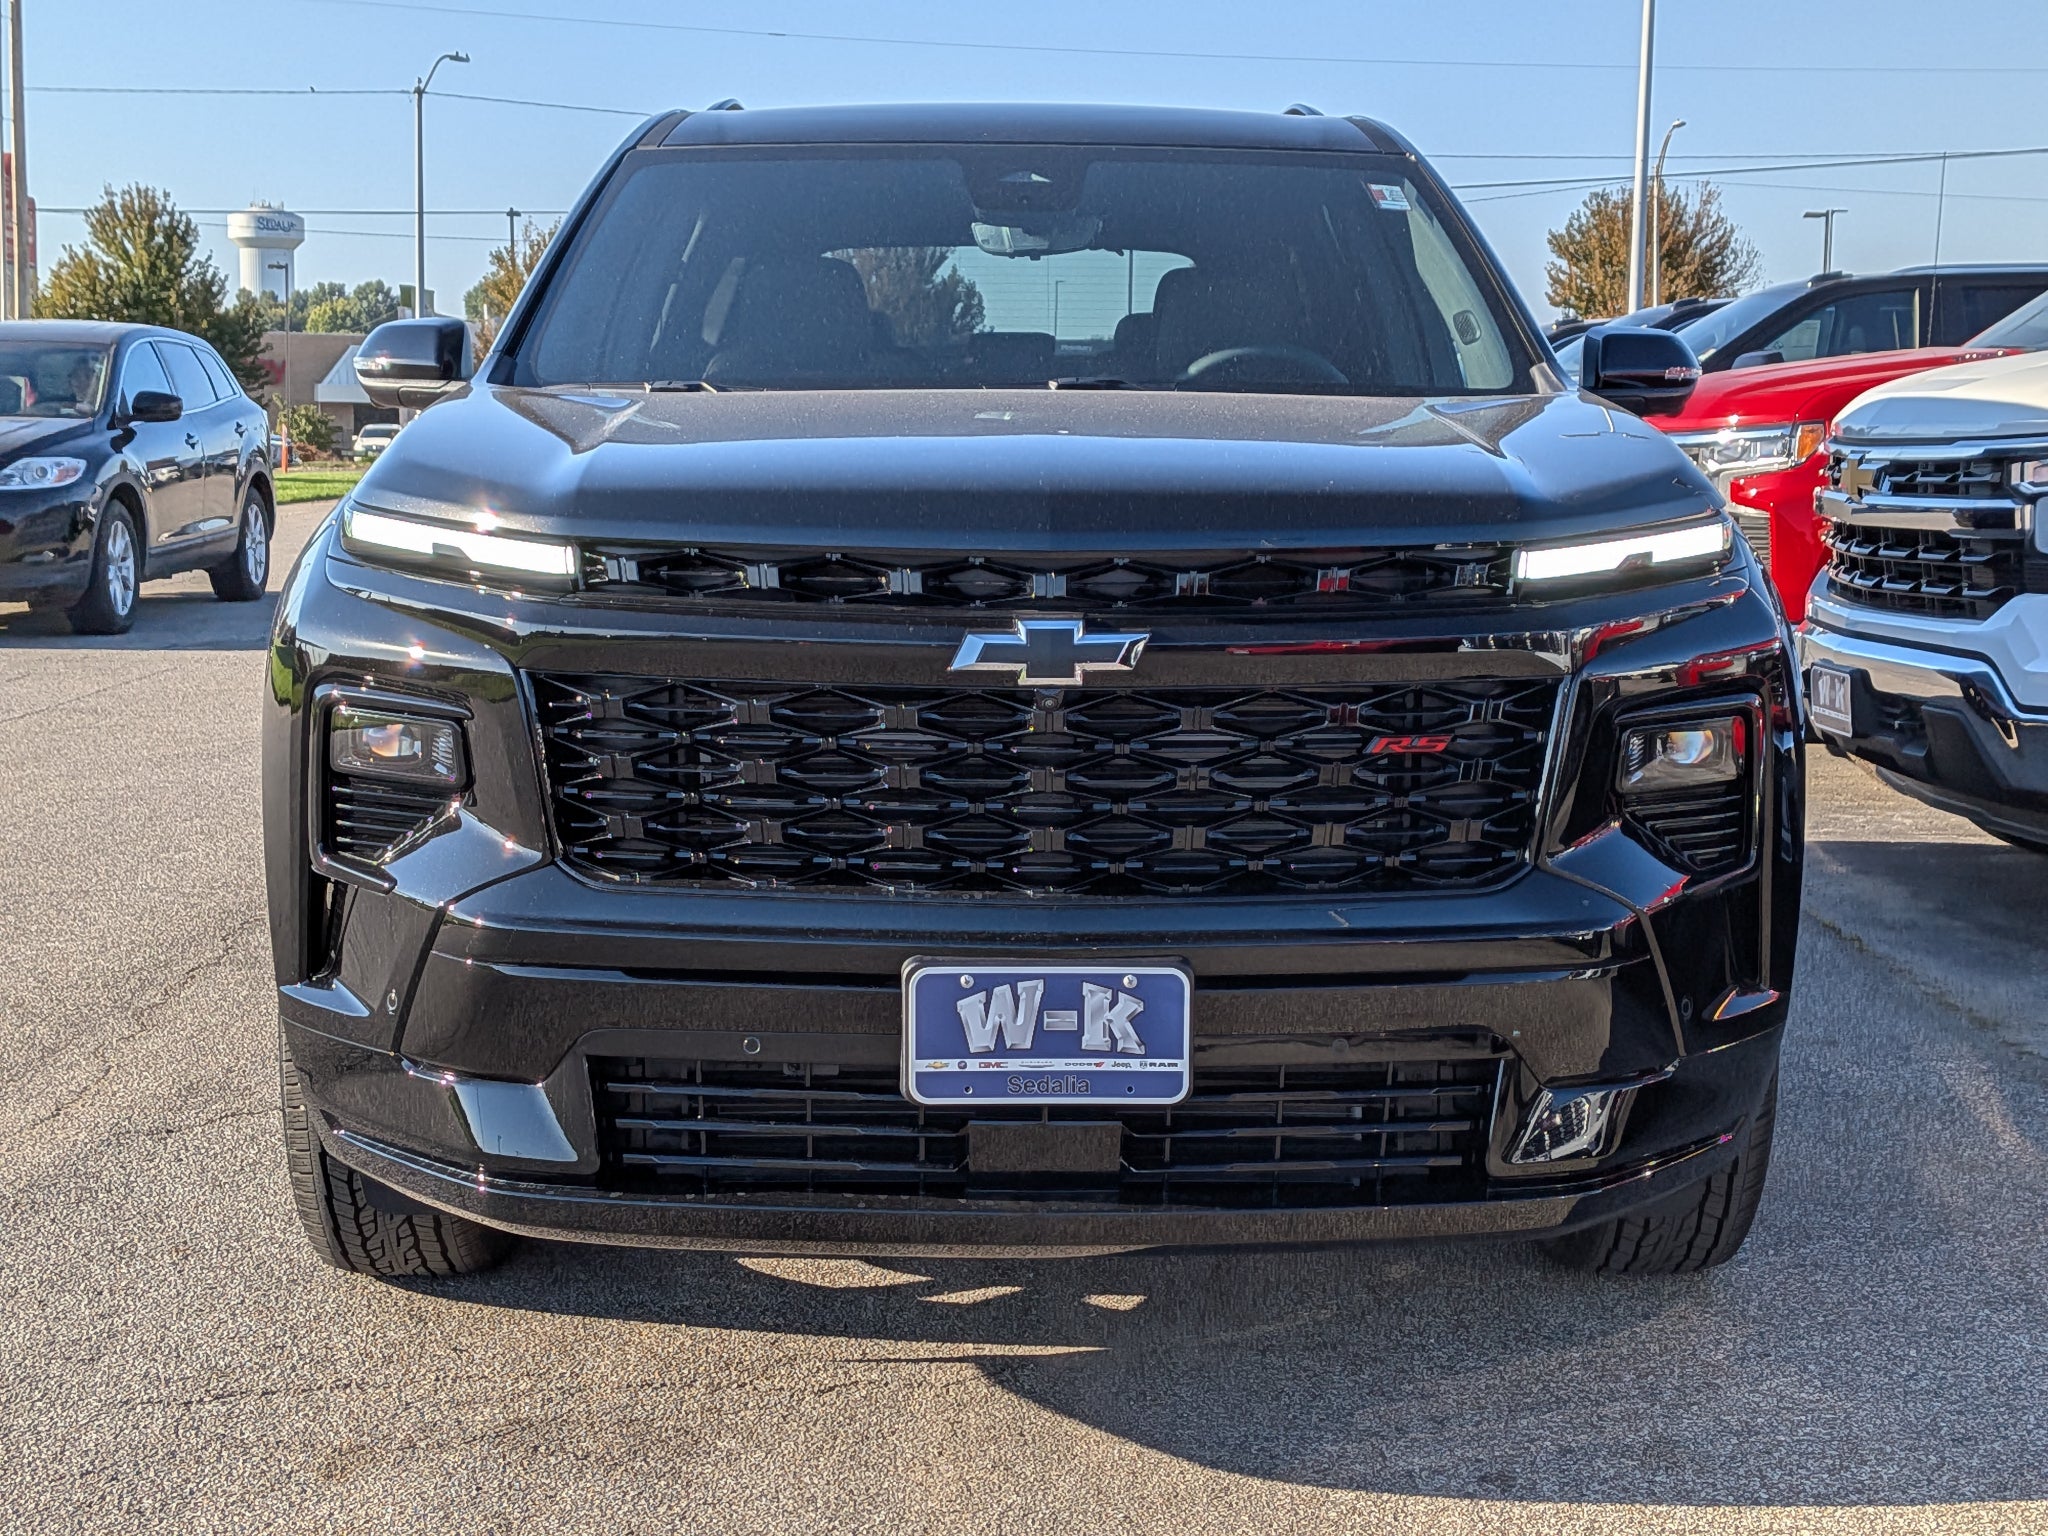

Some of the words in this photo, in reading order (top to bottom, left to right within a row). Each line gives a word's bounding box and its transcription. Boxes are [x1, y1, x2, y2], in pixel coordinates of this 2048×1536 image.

[1371, 736, 1452, 754] RS
[956, 978, 1146, 1055] W-K
[978, 1061, 1009, 1069] GMC
[1111, 1060, 1132, 1069] Jeep
[1007, 1075, 1091, 1095] Sedalia
